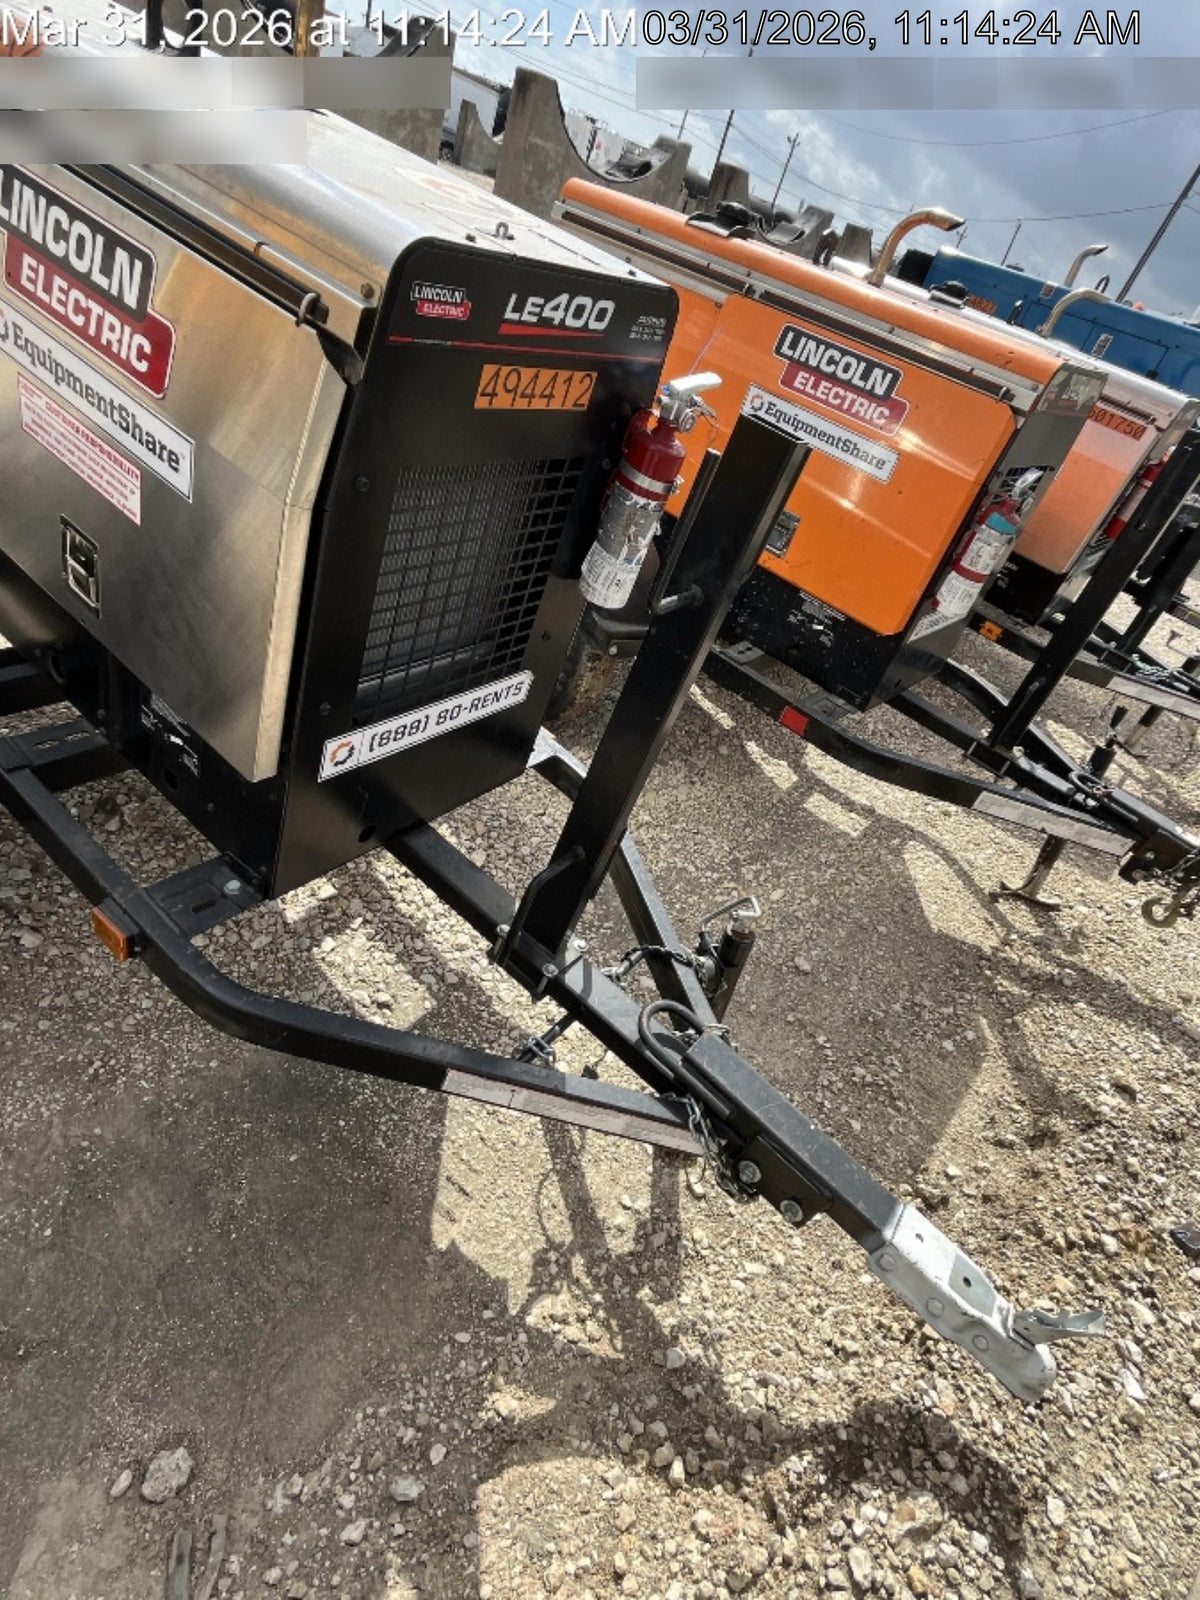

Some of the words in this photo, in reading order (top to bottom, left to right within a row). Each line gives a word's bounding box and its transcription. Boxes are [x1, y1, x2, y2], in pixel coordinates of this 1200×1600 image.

[0, 168, 143, 310] LINCOLN
[20, 252, 151, 373] ELECTRIC
[413, 285, 463, 303] LINCOLN
[423, 303, 465, 318] ELECTRIC
[503, 292, 616, 330] LE400
[11, 320, 182, 474] EquipmentShare
[479, 364, 594, 409] 494412
[779, 330, 893, 397] LINCOLN
[792, 371, 890, 428] ELECTRIC
[764, 401, 887, 471] EquipmentShare
[368, 714, 430, 753] (888)
[435, 680, 525, 726] 80-RENTS
